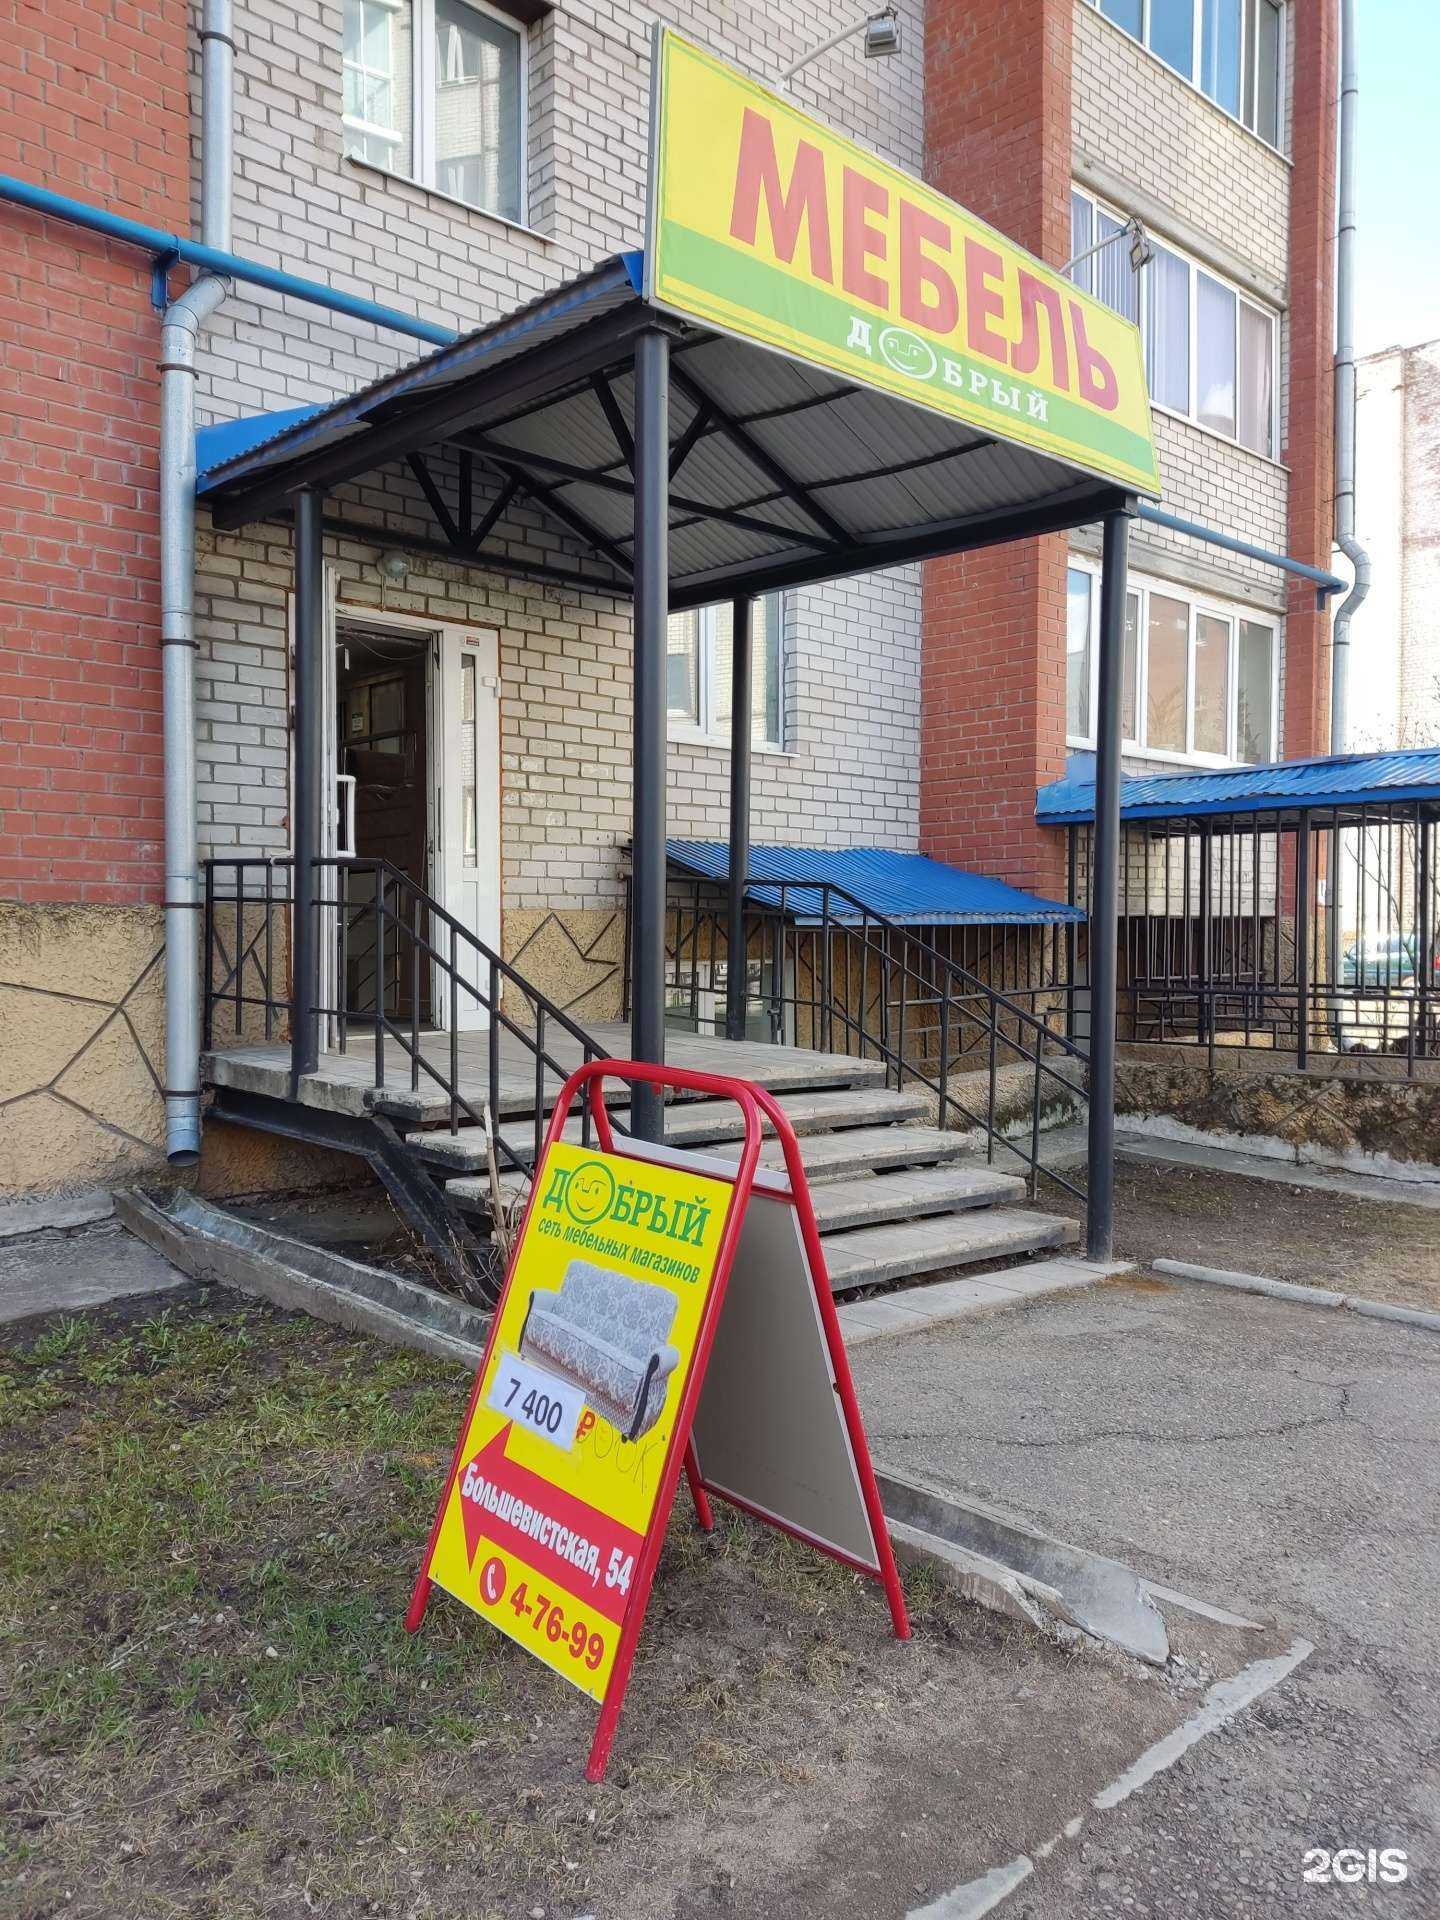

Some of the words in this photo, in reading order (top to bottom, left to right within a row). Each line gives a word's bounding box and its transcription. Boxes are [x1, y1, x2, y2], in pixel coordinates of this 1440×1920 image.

[729, 106, 1119, 413] МЕБЕЛЬ
[538, 1217, 563, 1238] сеть
[563, 1225, 630, 1261] мебельных
[629, 1246, 701, 1284] магазинов
[461, 1462, 601, 1587] Большевистская,
[605, 1547, 634, 1596] 54
[510, 1582, 604, 1670] 4-76-99
